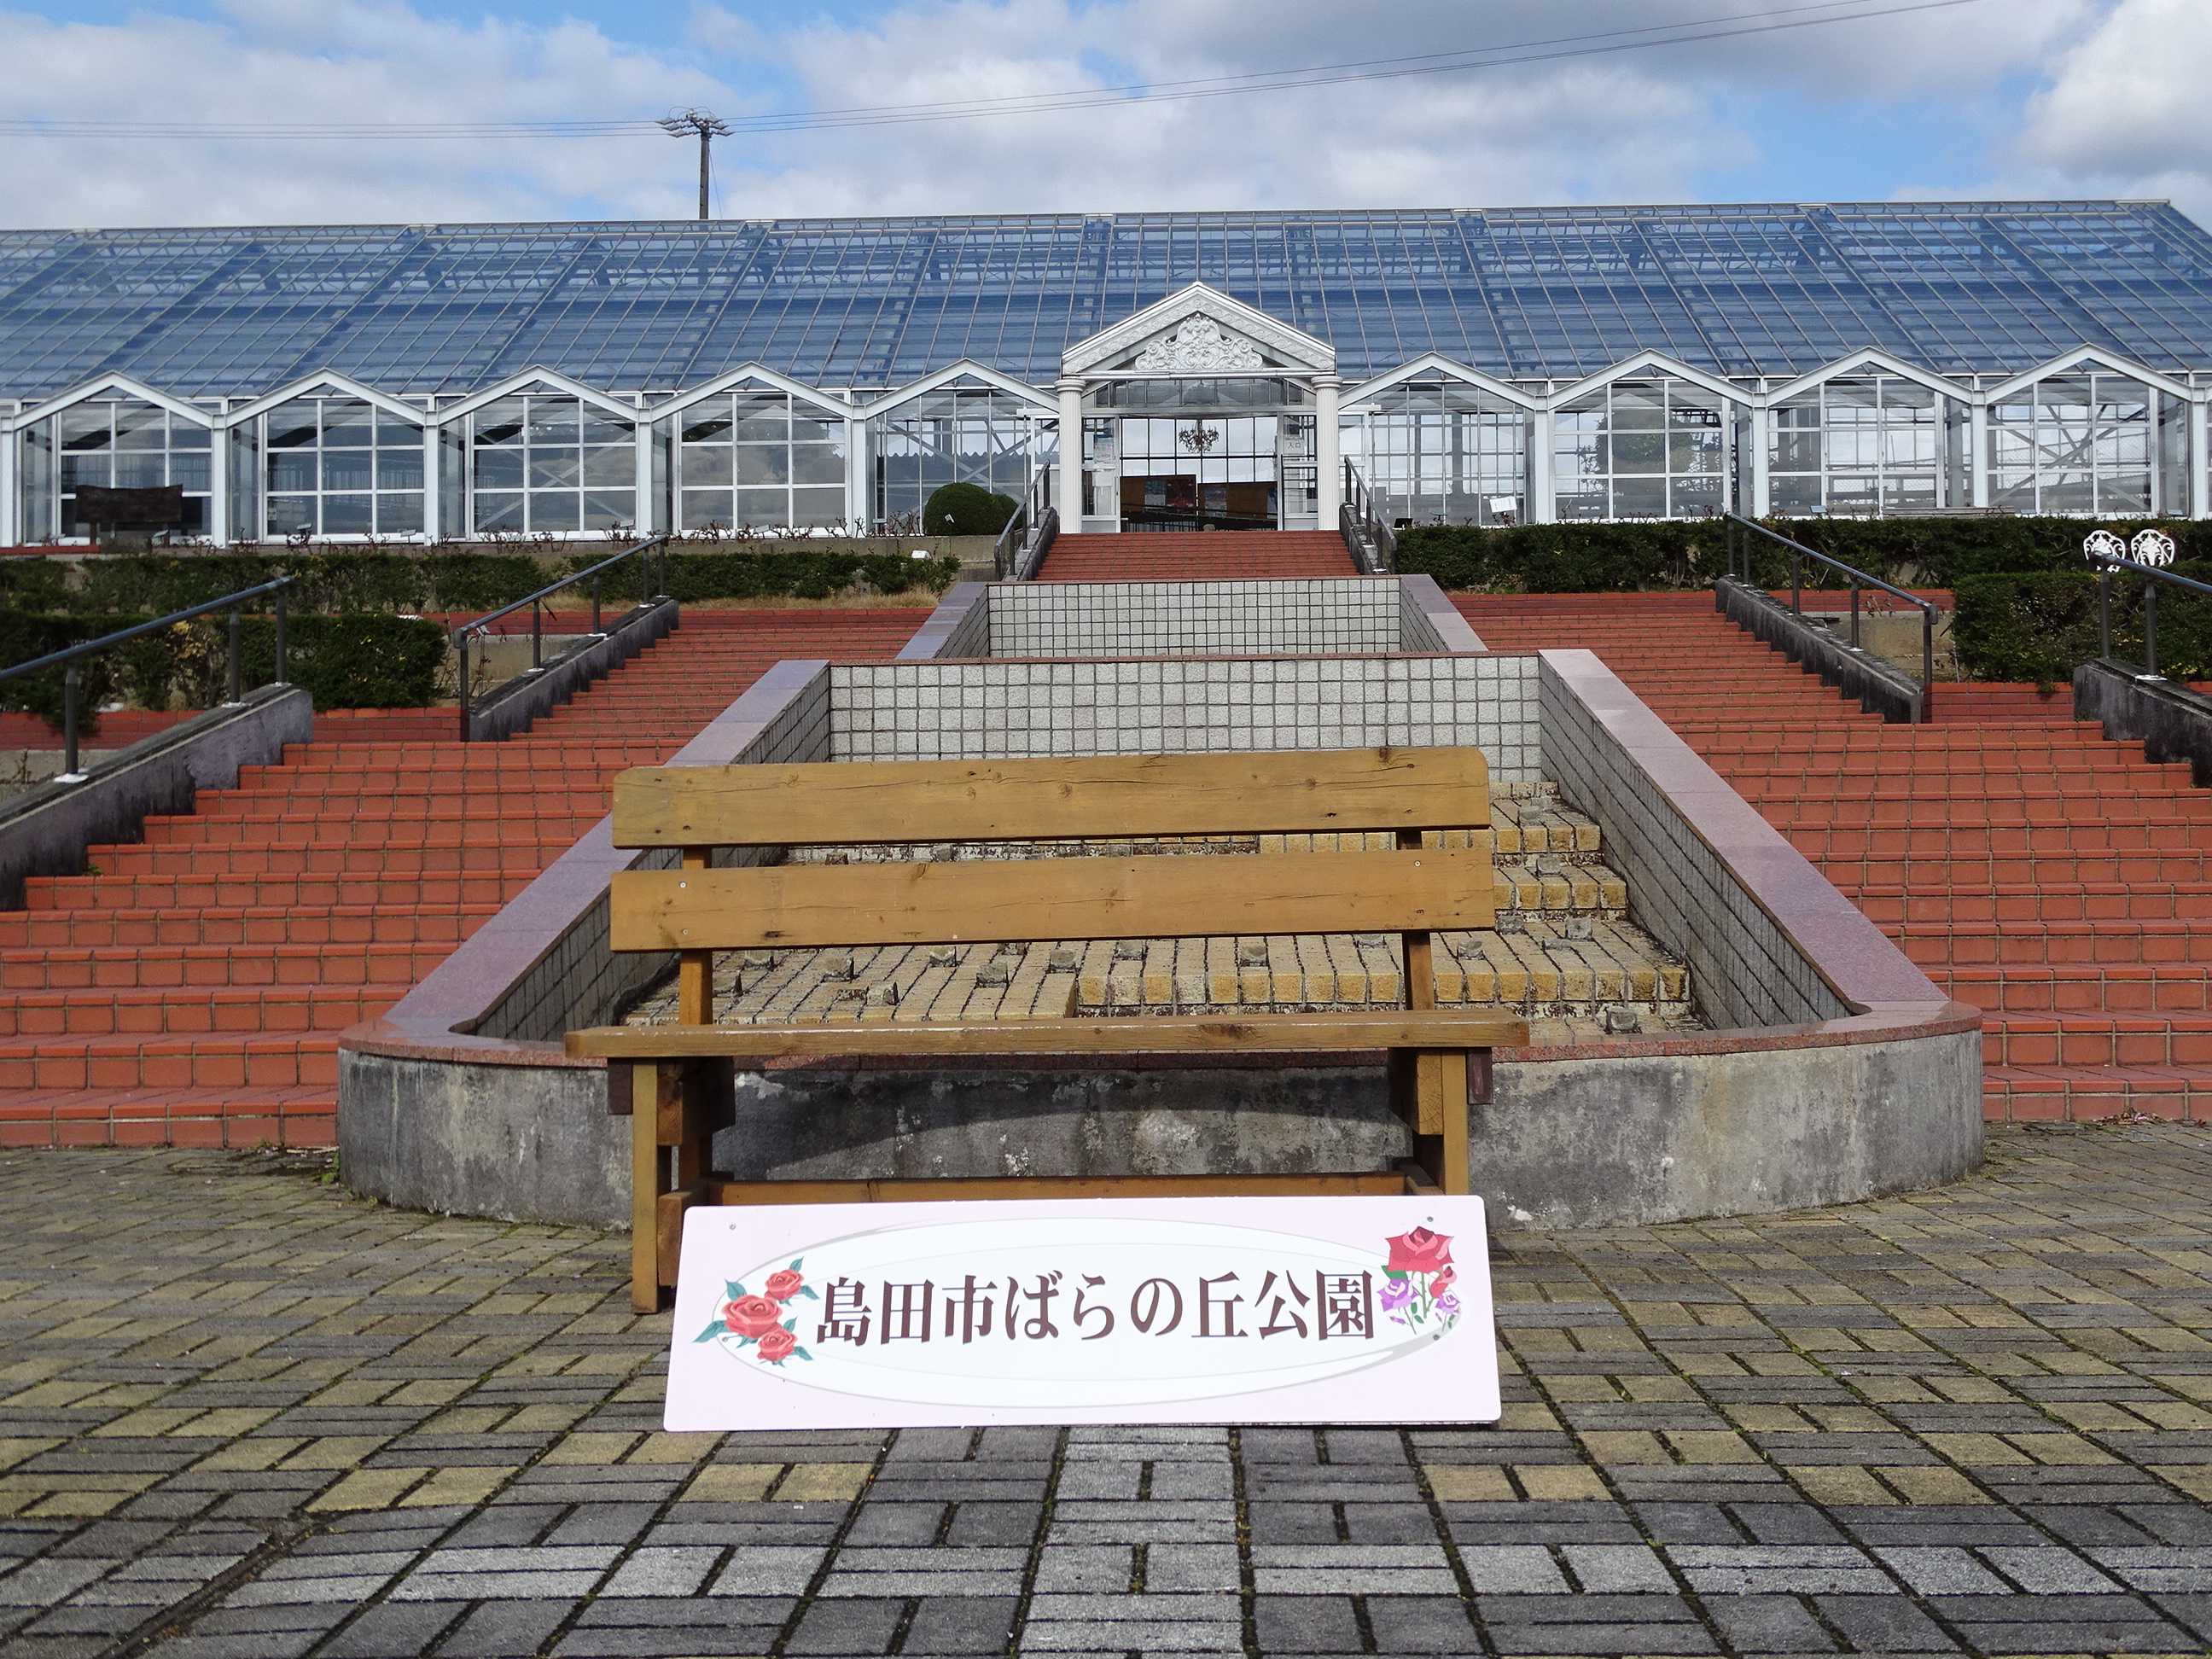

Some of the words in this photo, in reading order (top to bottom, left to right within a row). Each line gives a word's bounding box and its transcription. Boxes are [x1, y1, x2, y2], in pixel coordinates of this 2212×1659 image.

[817, 1269, 1374, 1347] 島田市ばらの丘公園
